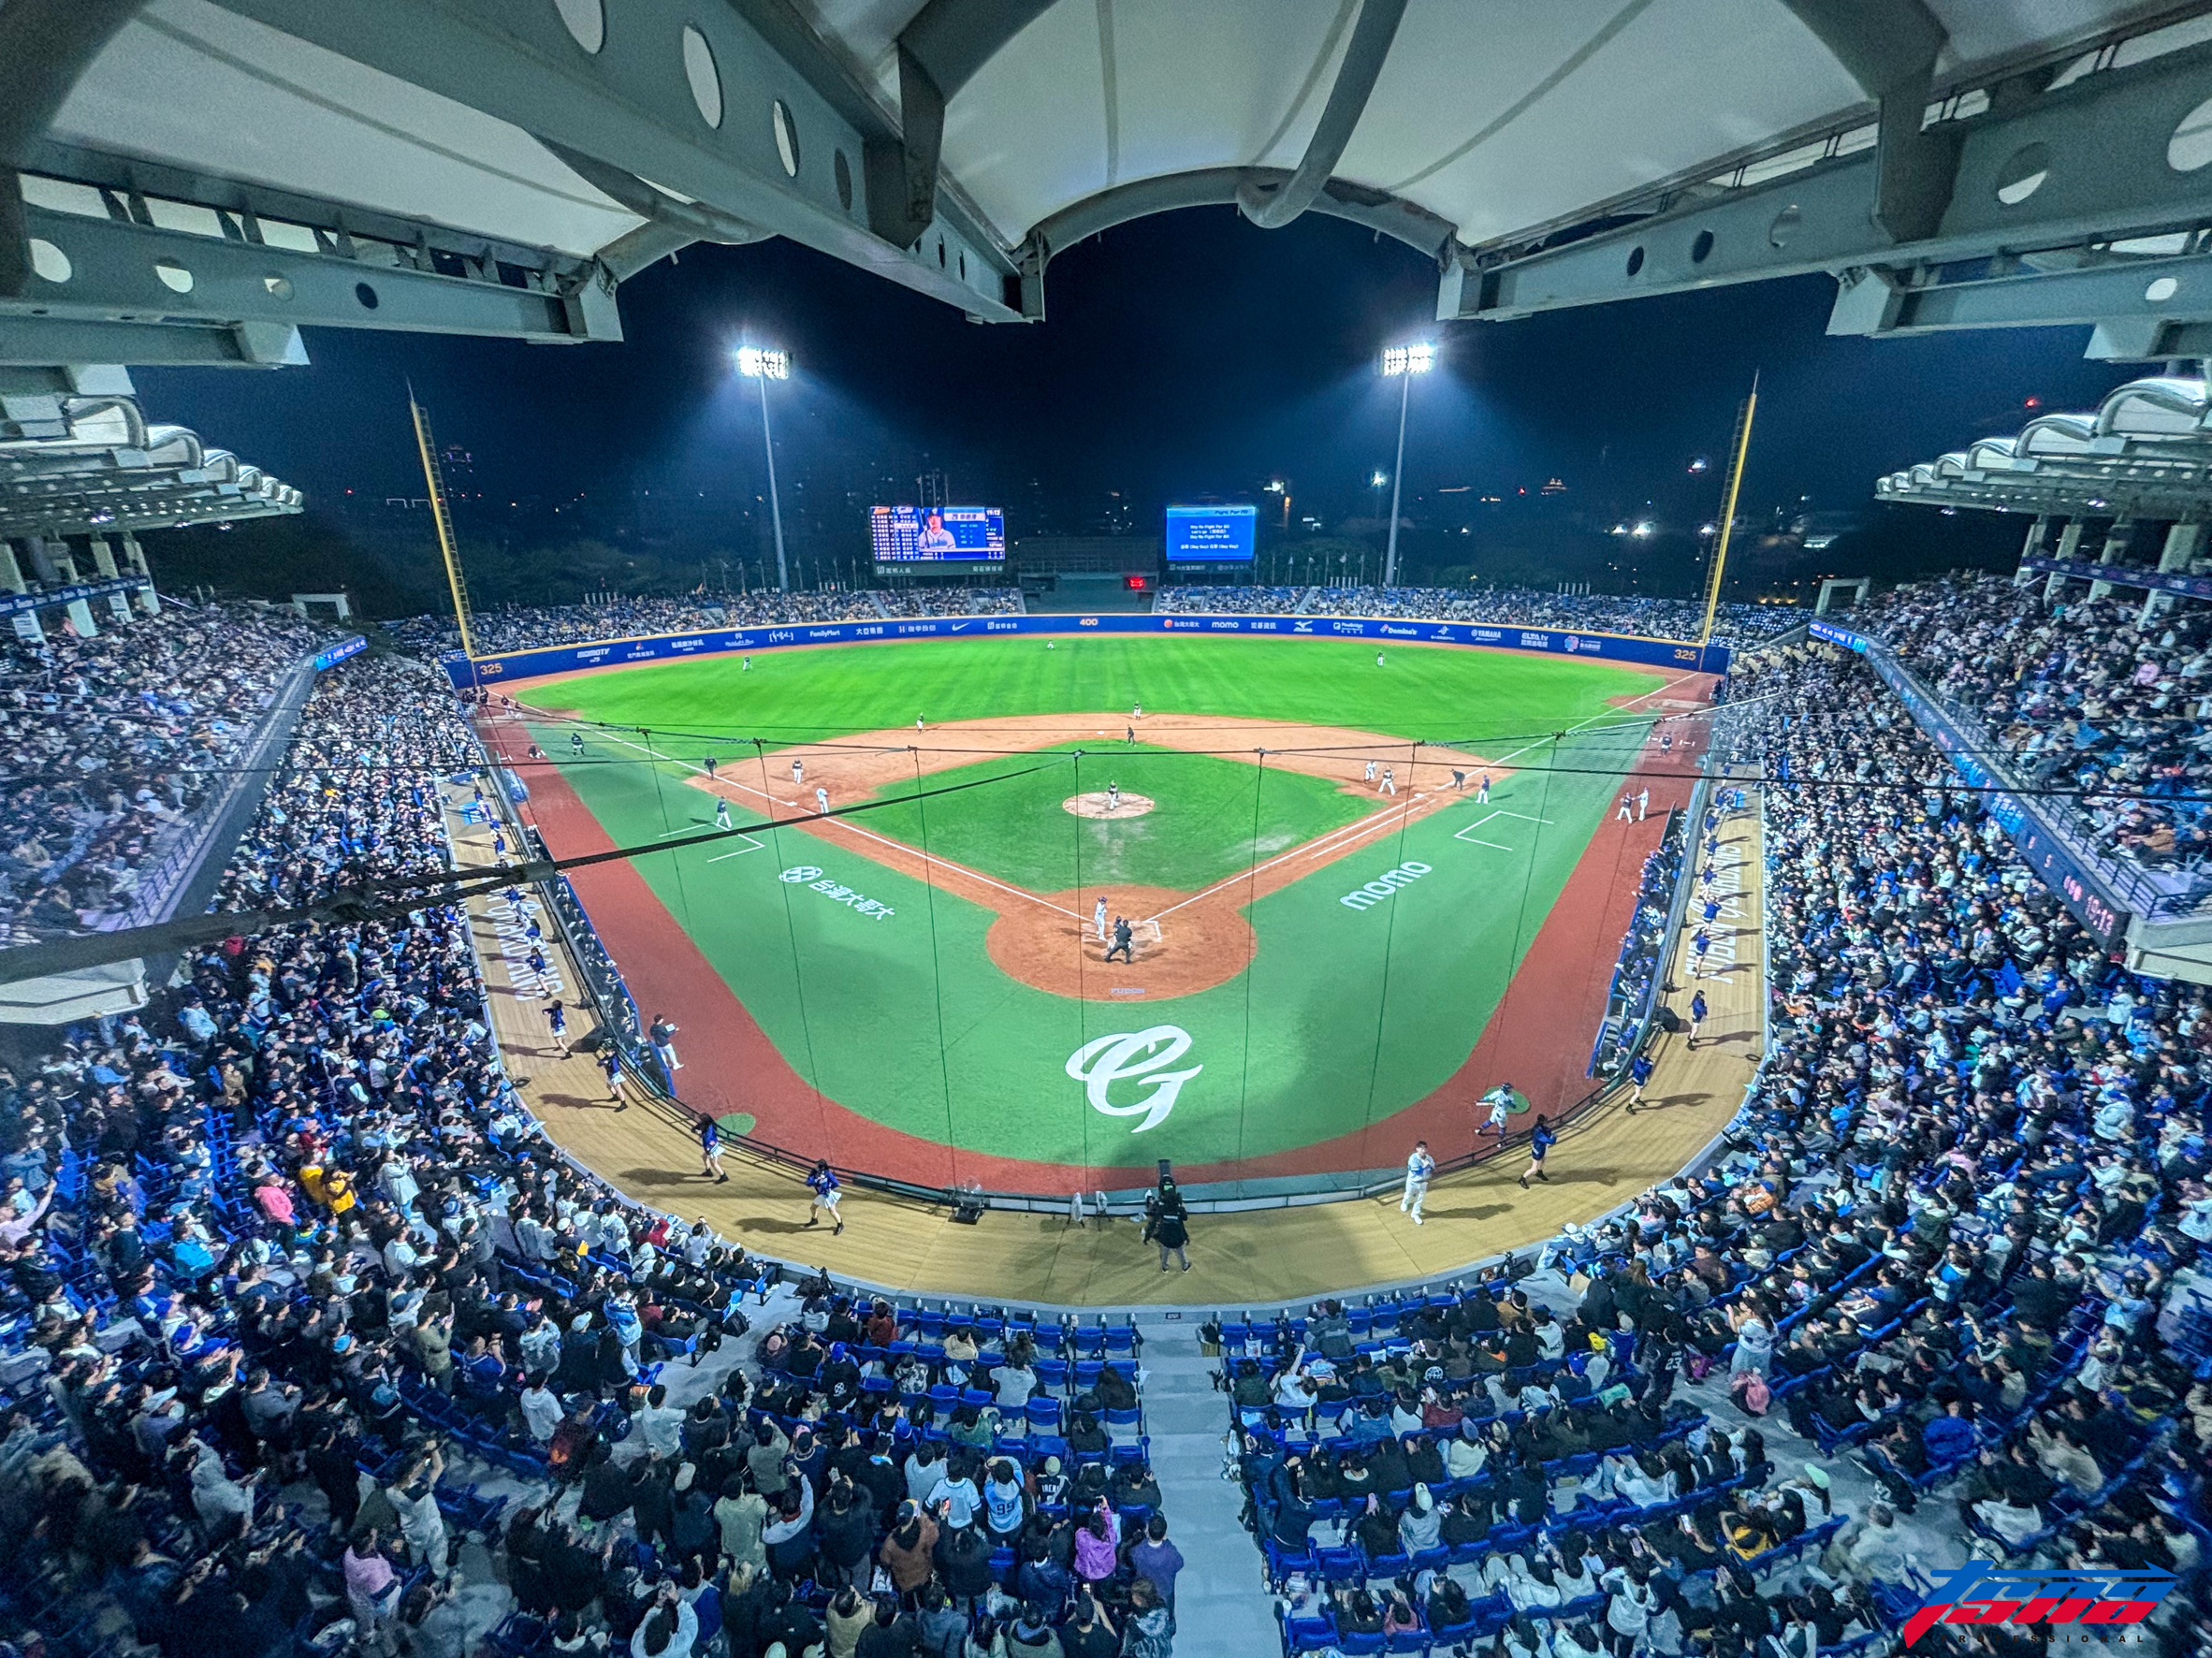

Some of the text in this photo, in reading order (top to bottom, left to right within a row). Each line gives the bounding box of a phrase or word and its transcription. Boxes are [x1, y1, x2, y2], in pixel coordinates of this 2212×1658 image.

[1079, 618, 1099, 627] 400
[1211, 620, 1240, 629] momo
[809, 629, 841, 638] FamilyMart
[1388, 627, 1418, 635] Domino's
[1477, 630, 1502, 639] YAMAHA
[1521, 632, 1540, 641] ELTA
[1673, 648, 1696, 662] 325
[479, 662, 503, 676] 325
[1340, 861, 1433, 911] momo
[808, 880, 895, 921] 台灣大哥大
[1665, 1357, 1682, 1371] 23
[997, 1500, 1015, 1516] 99
